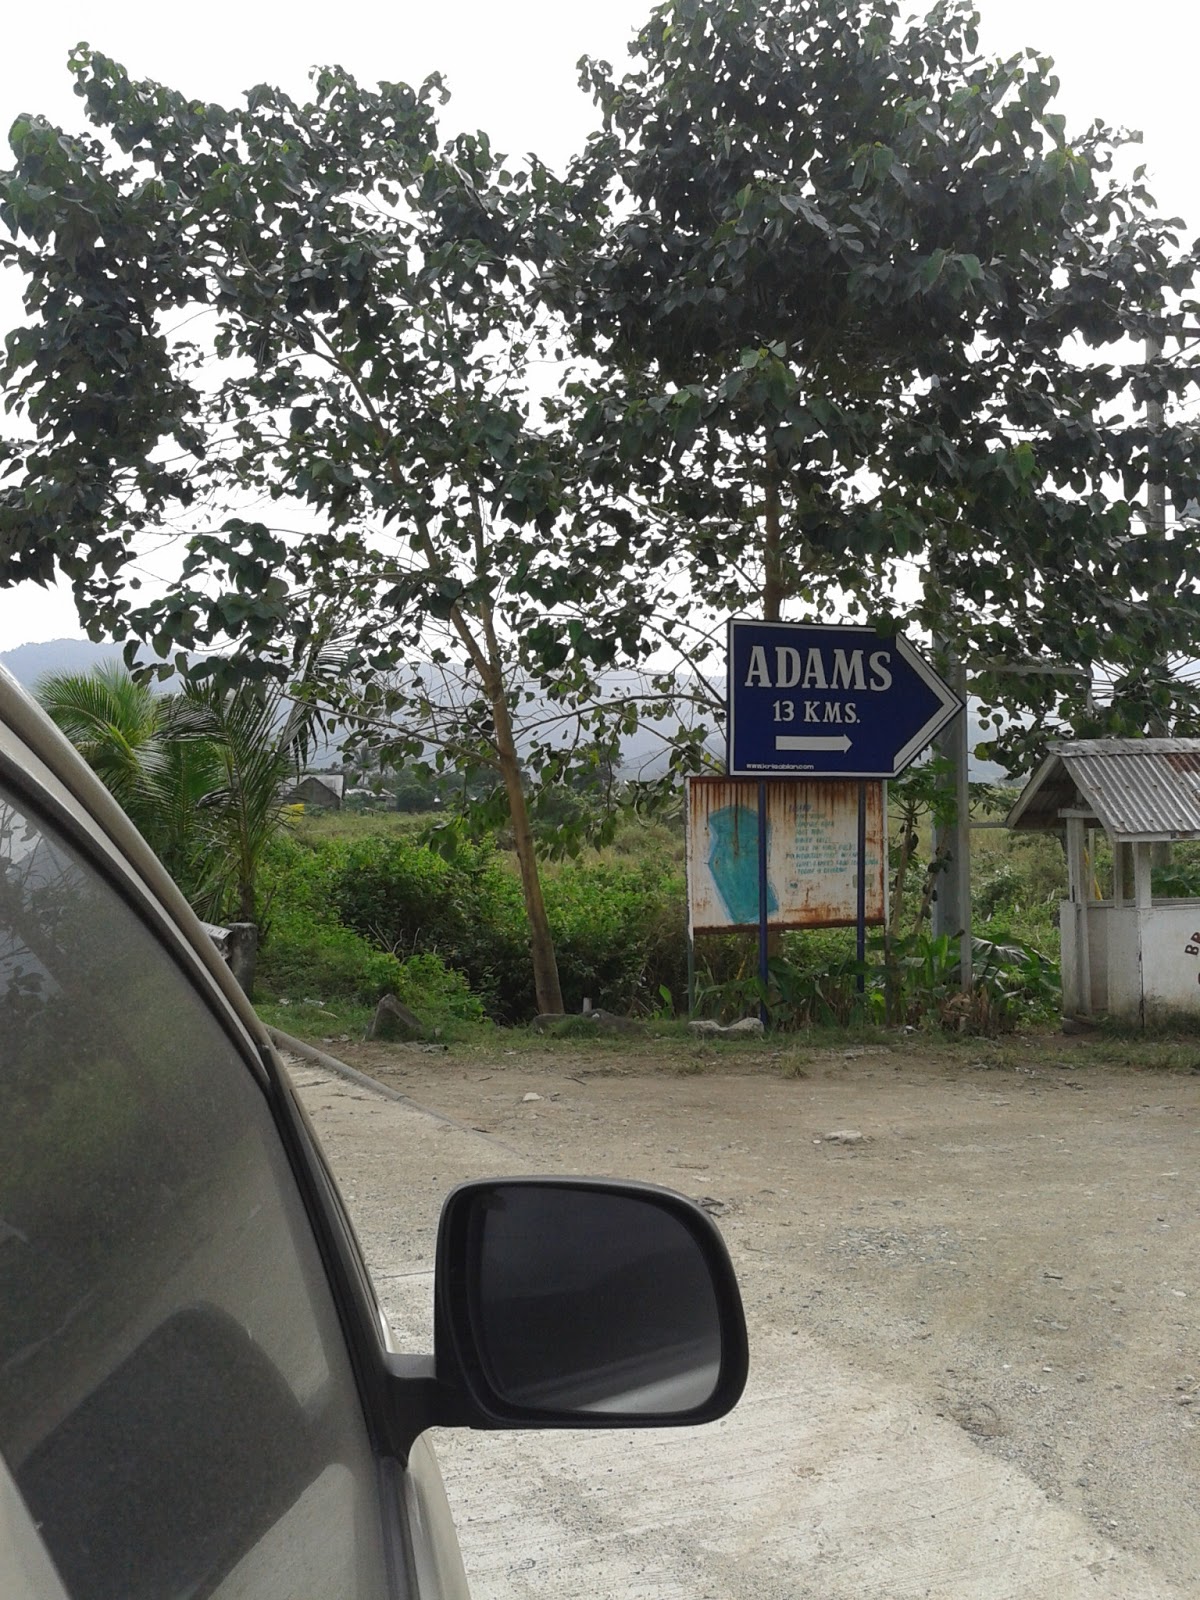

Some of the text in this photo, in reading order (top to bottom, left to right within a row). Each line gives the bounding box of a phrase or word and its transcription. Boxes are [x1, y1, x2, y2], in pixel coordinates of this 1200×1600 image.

[744, 645, 893, 691] ADAMS
[773, 700, 861, 724] 13 KMS.
